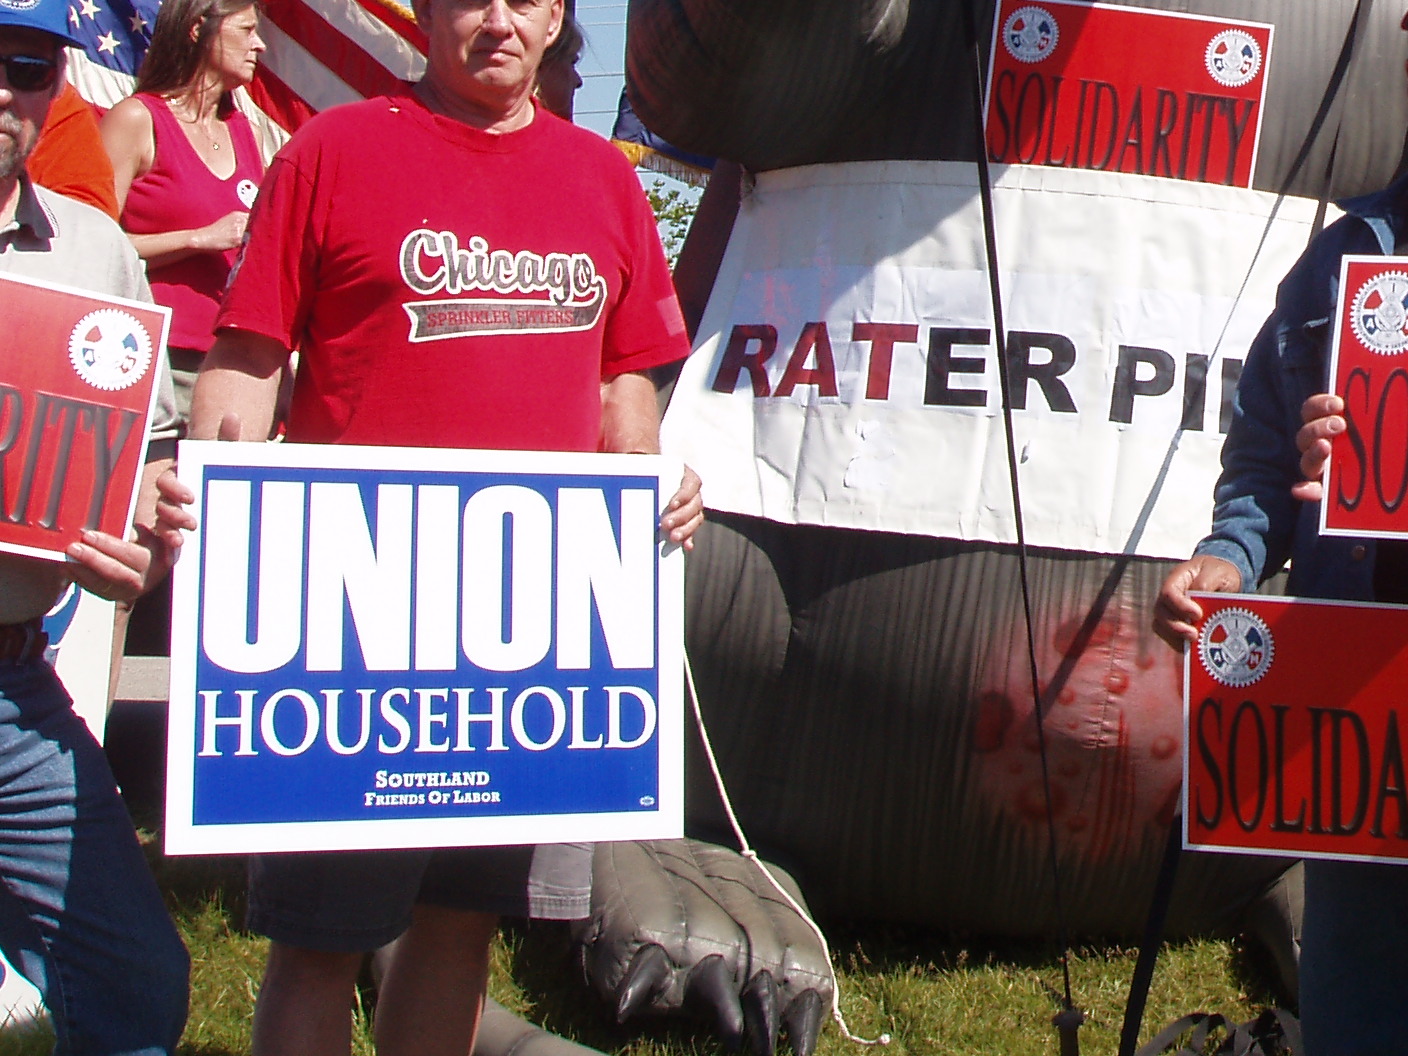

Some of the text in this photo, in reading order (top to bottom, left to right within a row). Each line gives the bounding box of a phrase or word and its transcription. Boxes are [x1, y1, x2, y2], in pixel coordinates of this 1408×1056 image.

[989, 68, 1258, 186] SOLIDARITY
[400, 229, 605, 308] Chicago
[427, 309, 575, 328] SPRINKLER FITTERS
[711, 320, 1078, 414] RATER
[202, 479, 656, 675] UNION
[197, 685, 658, 757] HOUSEHOLD
[364, 790, 501, 807] FRIENDS OF LABOR
[375, 769, 490, 789] SOUTHLAND
